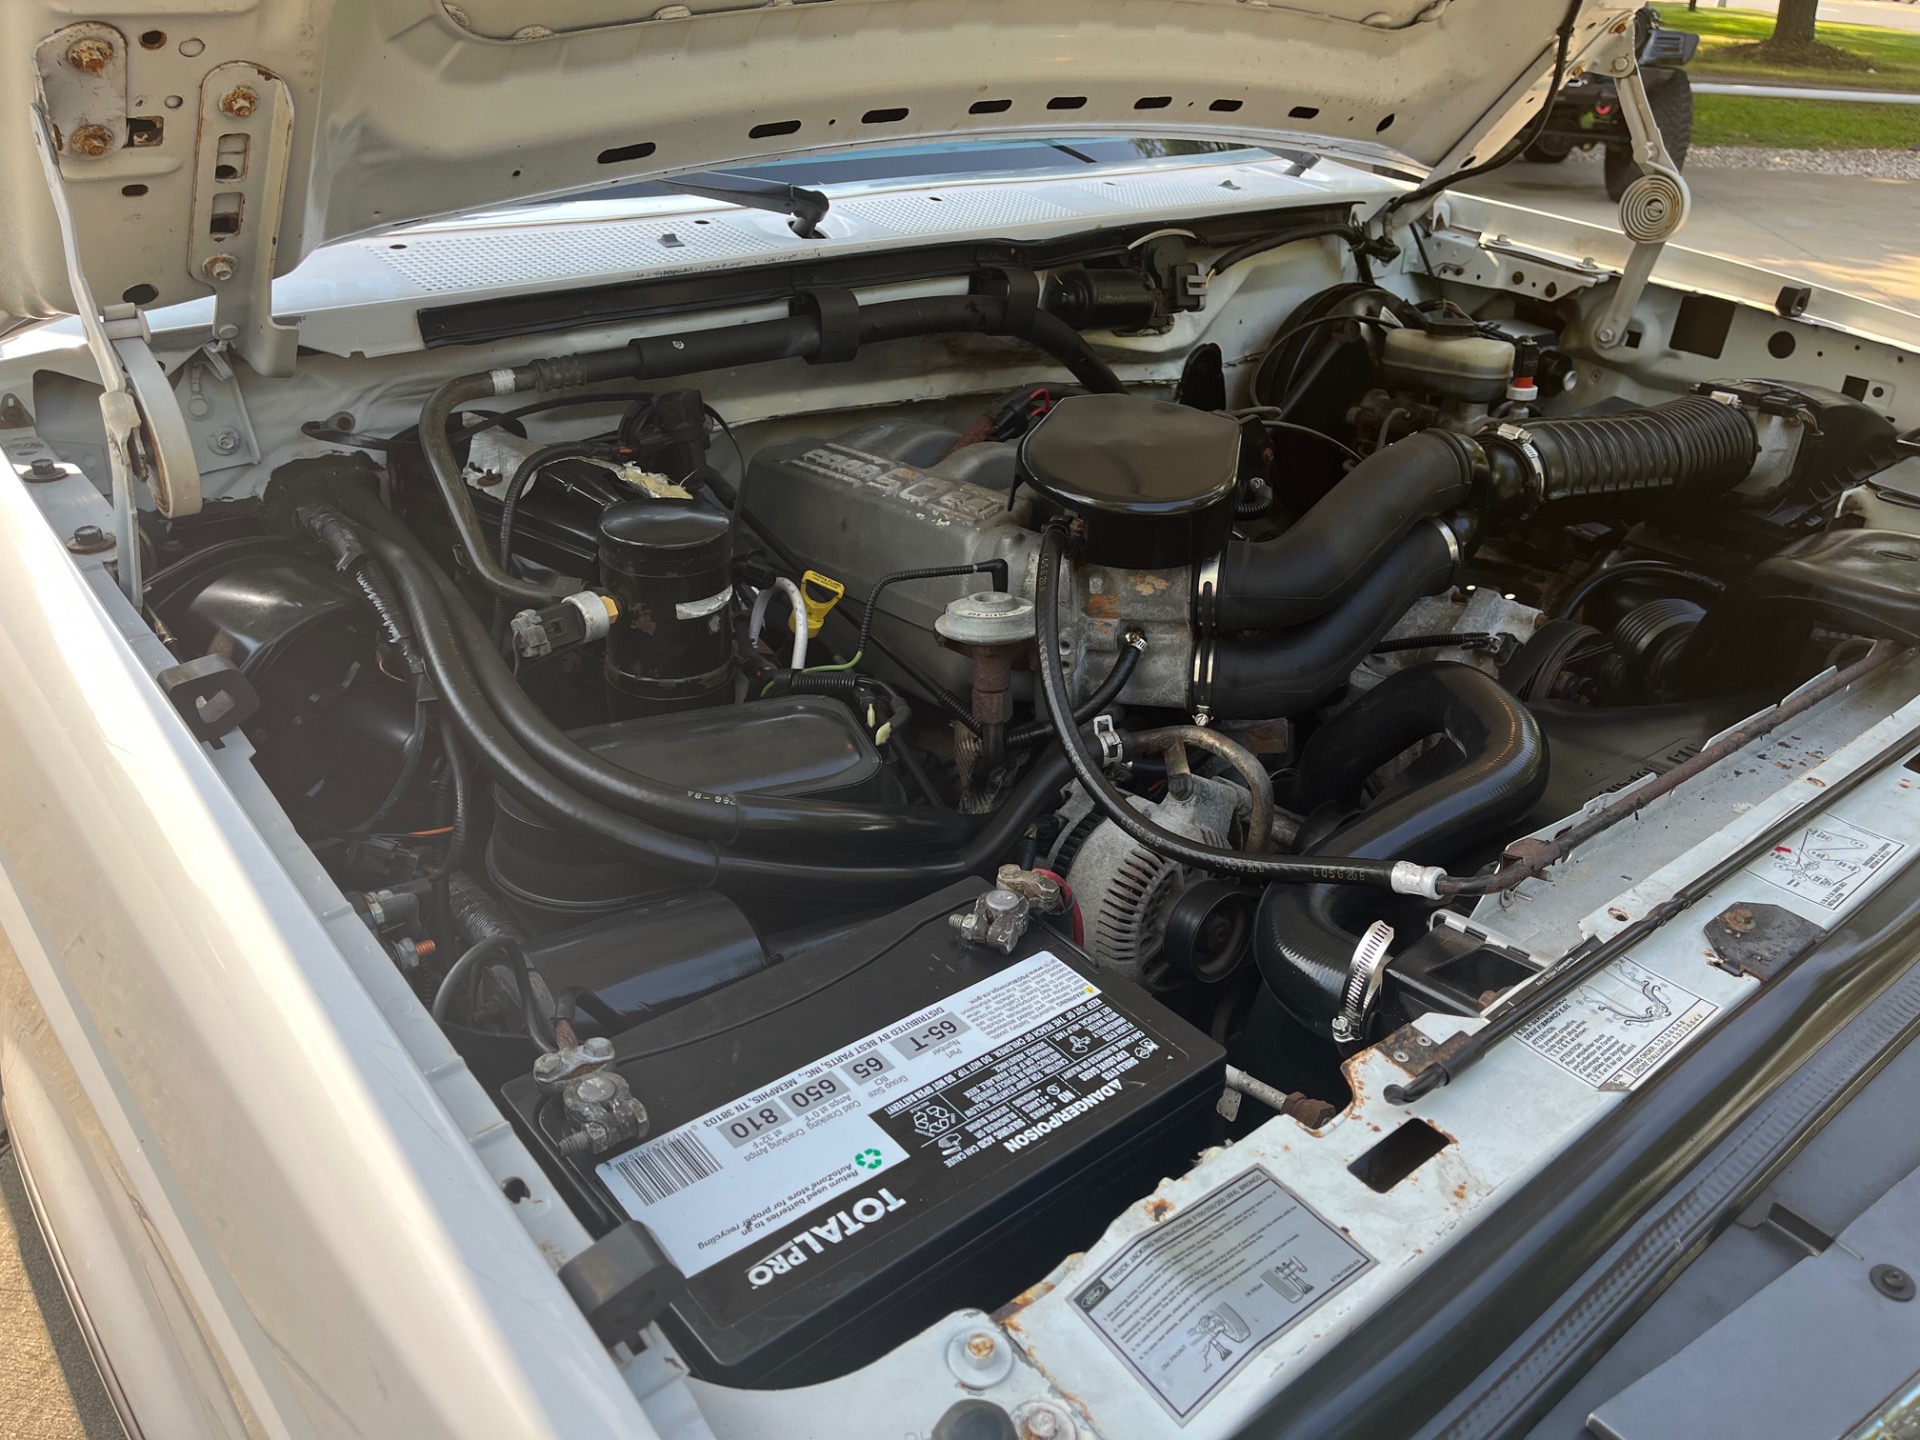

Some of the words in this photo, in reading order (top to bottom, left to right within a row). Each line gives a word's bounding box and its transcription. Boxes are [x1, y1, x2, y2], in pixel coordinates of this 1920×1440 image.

[890, 1006, 944, 1035] DISTRIBUTED
[877, 1032, 891, 1042] BY
[909, 1020, 956, 1051] 65-T
[854, 1039, 877, 1054] BEST
[932, 1039, 960, 1055] Number
[945, 1047, 962, 1058] Part
[820, 1050, 854, 1068] PARTS,
[1096, 1050, 1129, 1070] EXPLOSIVE
[1115, 1056, 1138, 1071] SHIELD
[852, 1057, 883, 1078] 65
[1078, 1066, 1100, 1081] GASES
[1101, 1067, 1119, 1080] EYES
[873, 1075, 889, 1085] BCI
[884, 1075, 908, 1088] Group
[748, 1078, 797, 1103] MEMPHIS,
[791, 1079, 836, 1107] 650
[867, 1086, 885, 1097] Size
[1057, 1090, 1075, 1102] NO
[734, 1102, 749, 1112] TN
[828, 1093, 851, 1108] Amps
[841, 1099, 861, 1112] Cold
[818, 1105, 828, 1113] at
[703, 1109, 734, 1127] 38103
[730, 1108, 778, 1138] 810
[805, 1109, 843, 1129] Cranking
[767, 1128, 805, 1149] Cranking
[772, 1128, 782, 1137] at
[743, 1146, 768, 1161] Amps
[828, 1169, 858, 1187] Return
[787, 1186, 809, 1200] store
[806, 1185, 827, 1201] used
[765, 1197, 805, 1222] batteries
[773, 1199, 786, 1209] for
[742, 1206, 771, 1226] proper
[741, 1226, 752, 1235] an
[754, 1220, 764, 1228] to
[697, 1224, 739, 1249] recycling
[1108, 1260, 1130, 1282] TRUCK
[1131, 1237, 1155, 1263] JACKING
